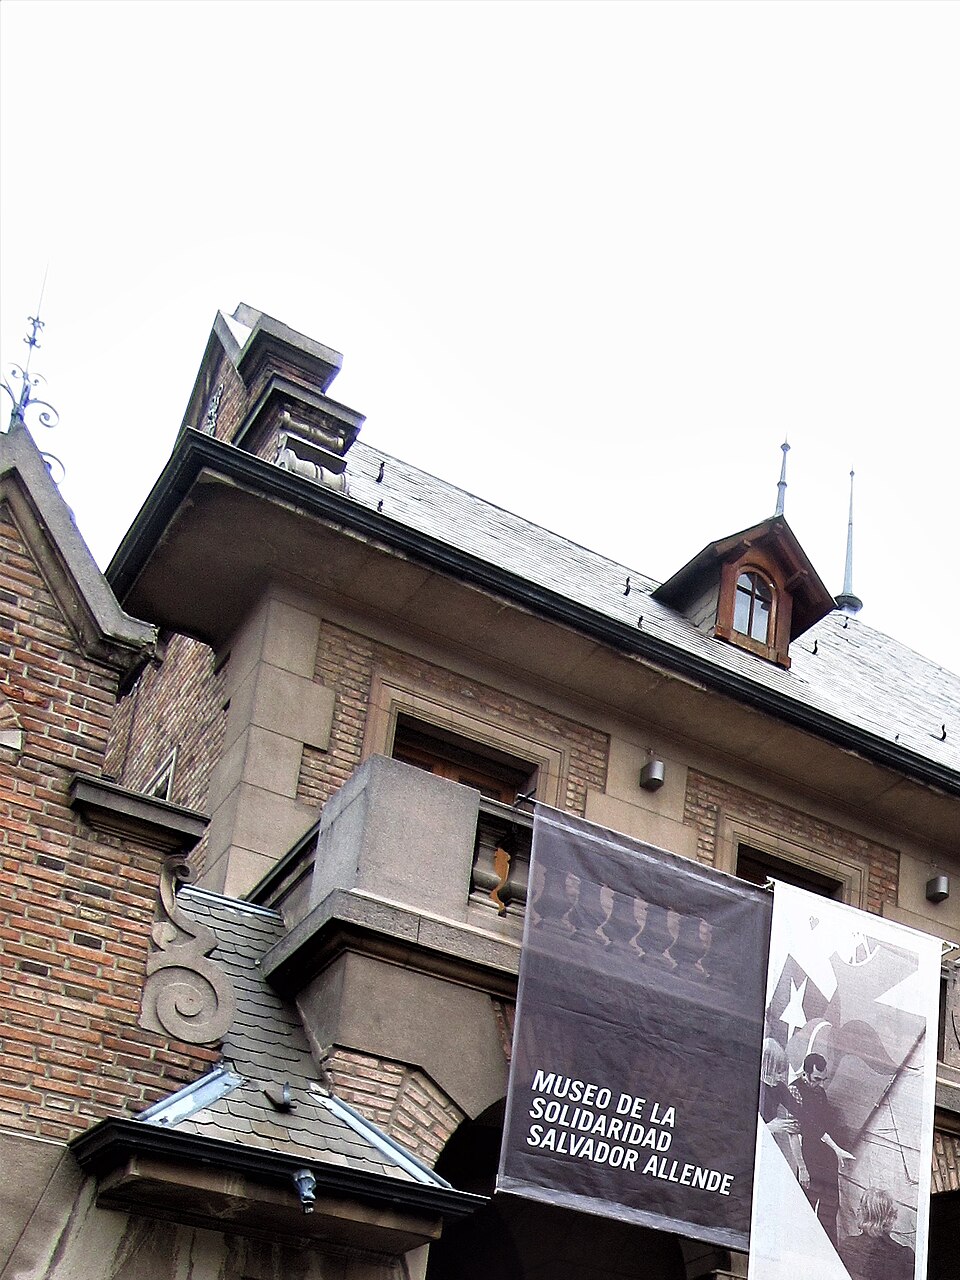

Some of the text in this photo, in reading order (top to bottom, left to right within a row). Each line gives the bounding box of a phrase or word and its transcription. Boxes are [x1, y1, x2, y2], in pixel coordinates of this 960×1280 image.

[528, 1097, 673, 1154] SOLIDARIDAD
[531, 1069, 677, 1128] MUSEO DE LA
[525, 1124, 736, 1196] SALVADOR ALLENDE
